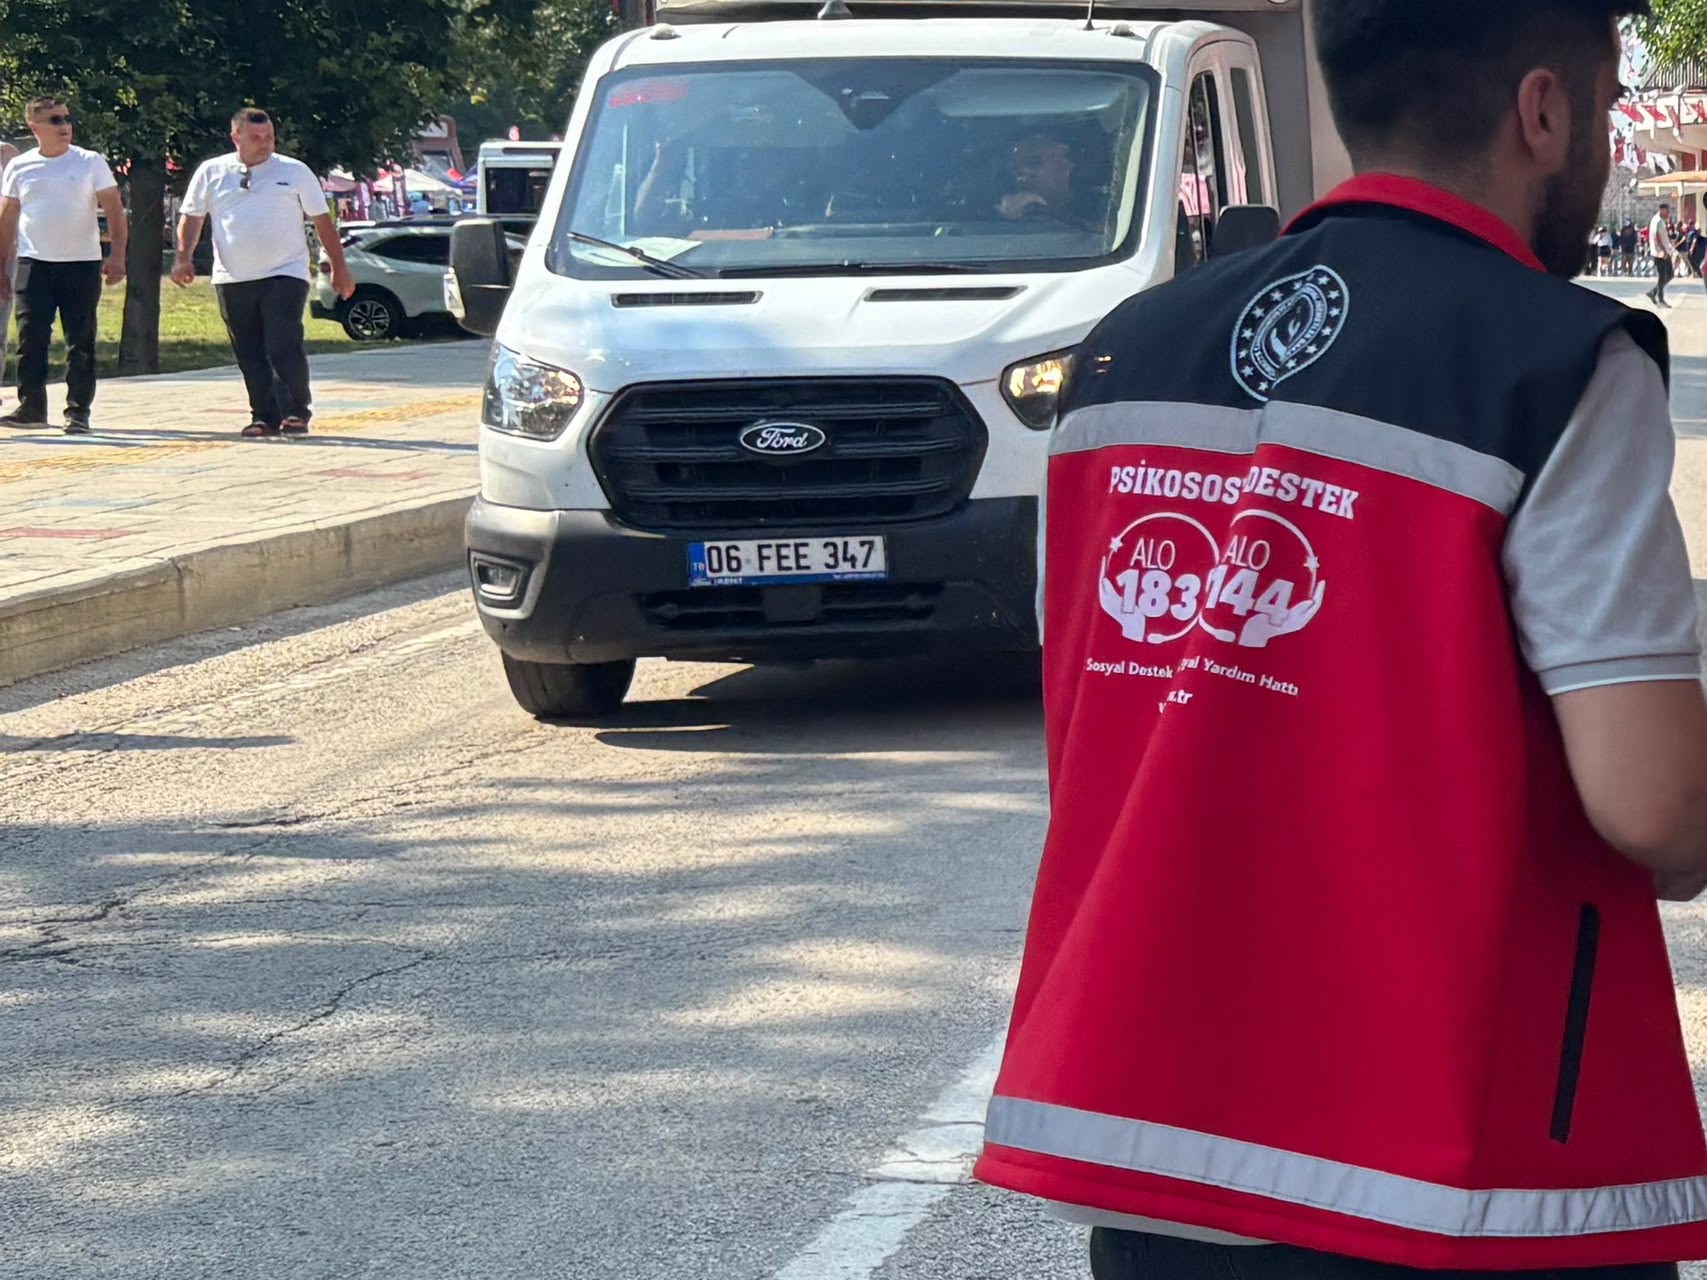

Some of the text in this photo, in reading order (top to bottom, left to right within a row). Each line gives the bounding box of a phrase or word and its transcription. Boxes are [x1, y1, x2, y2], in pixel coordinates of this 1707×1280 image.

[755, 426, 808, 449] Ford
[706, 539, 875, 575] 06 FEE 347
[1130, 537, 1176, 570] ALO
[1222, 534, 1270, 571] ALO
[1115, 569, 1201, 620] 183
[1205, 564, 1295, 626] 144
[1086, 657, 1174, 678] Sosyal Destek
[1203, 657, 1255, 685] Yardım
[1258, 673, 1299, 697] Hattı
